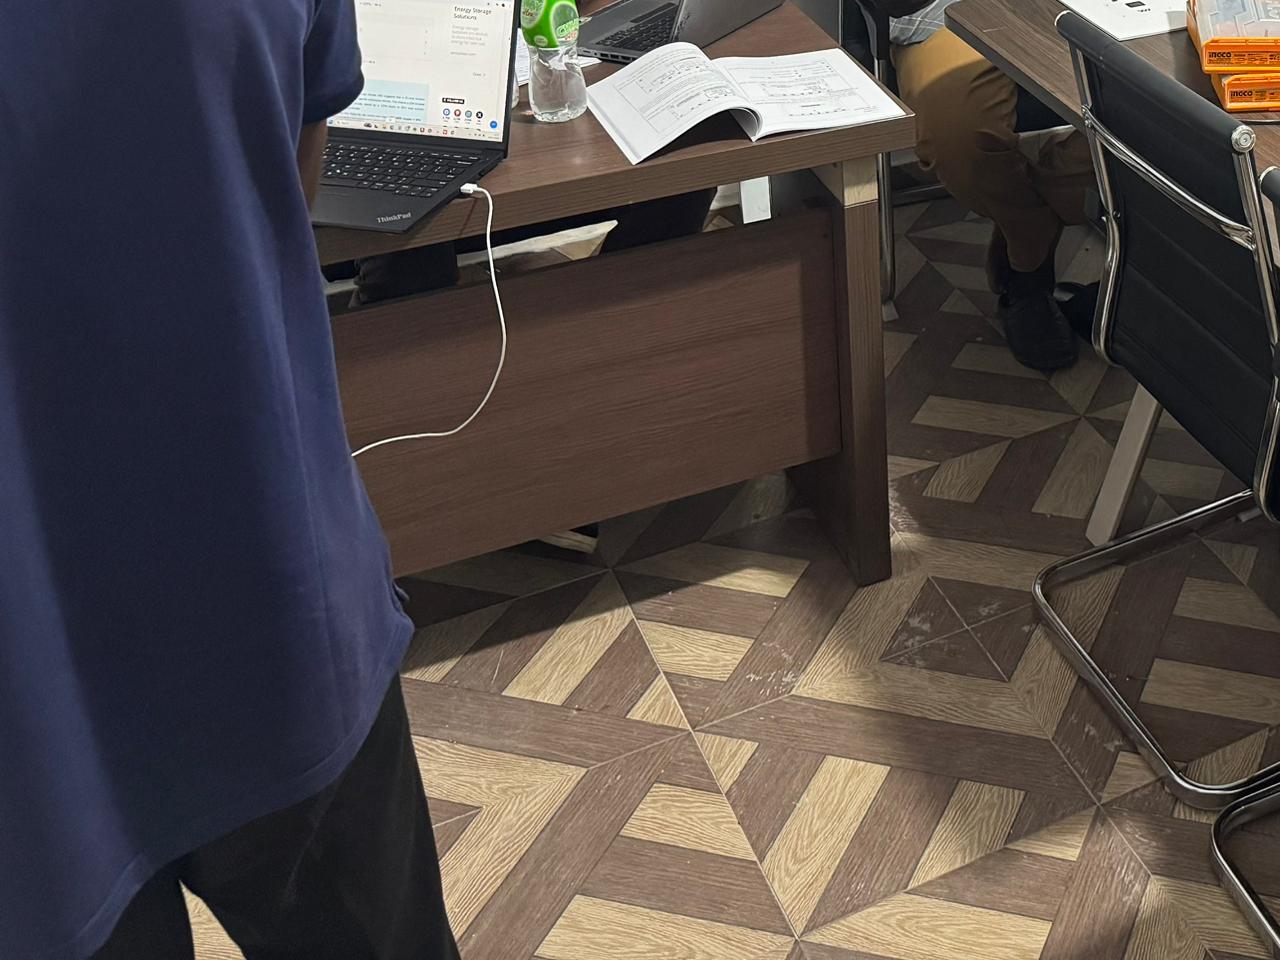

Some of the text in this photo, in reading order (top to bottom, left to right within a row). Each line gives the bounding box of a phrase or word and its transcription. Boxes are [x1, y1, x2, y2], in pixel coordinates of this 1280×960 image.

[454, 6, 492, 16] Energy Storage
[453, 13, 477, 21] Solutions
[376, 211, 412, 223] ThinkPad
